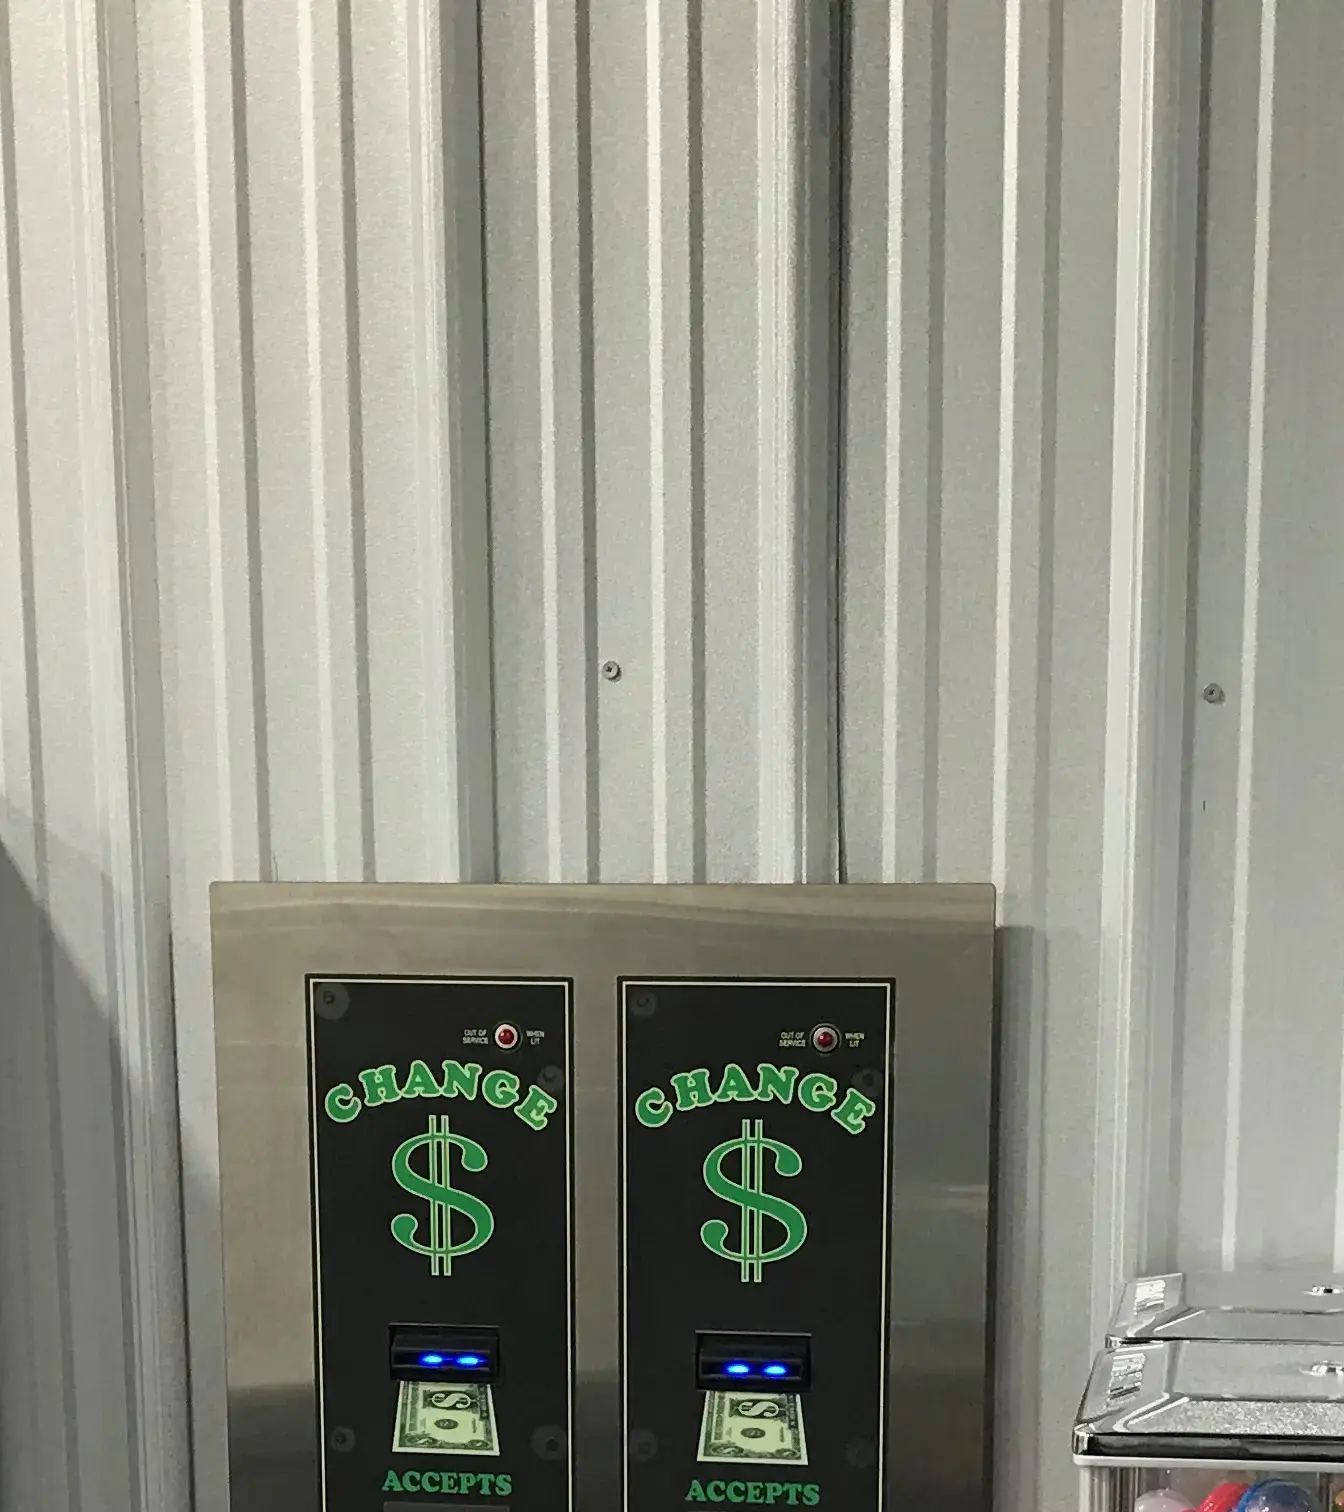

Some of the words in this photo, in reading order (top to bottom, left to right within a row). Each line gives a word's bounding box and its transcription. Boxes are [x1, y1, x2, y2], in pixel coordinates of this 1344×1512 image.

[325, 1060, 557, 1130] CHANGE
[635, 1063, 875, 1134] CHANGE
[390, 1115, 495, 1276] $
[700, 1119, 807, 1282] $
[382, 1470, 513, 1496] ACCEPTS
[685, 1479, 820, 1505] ACCEPTS
